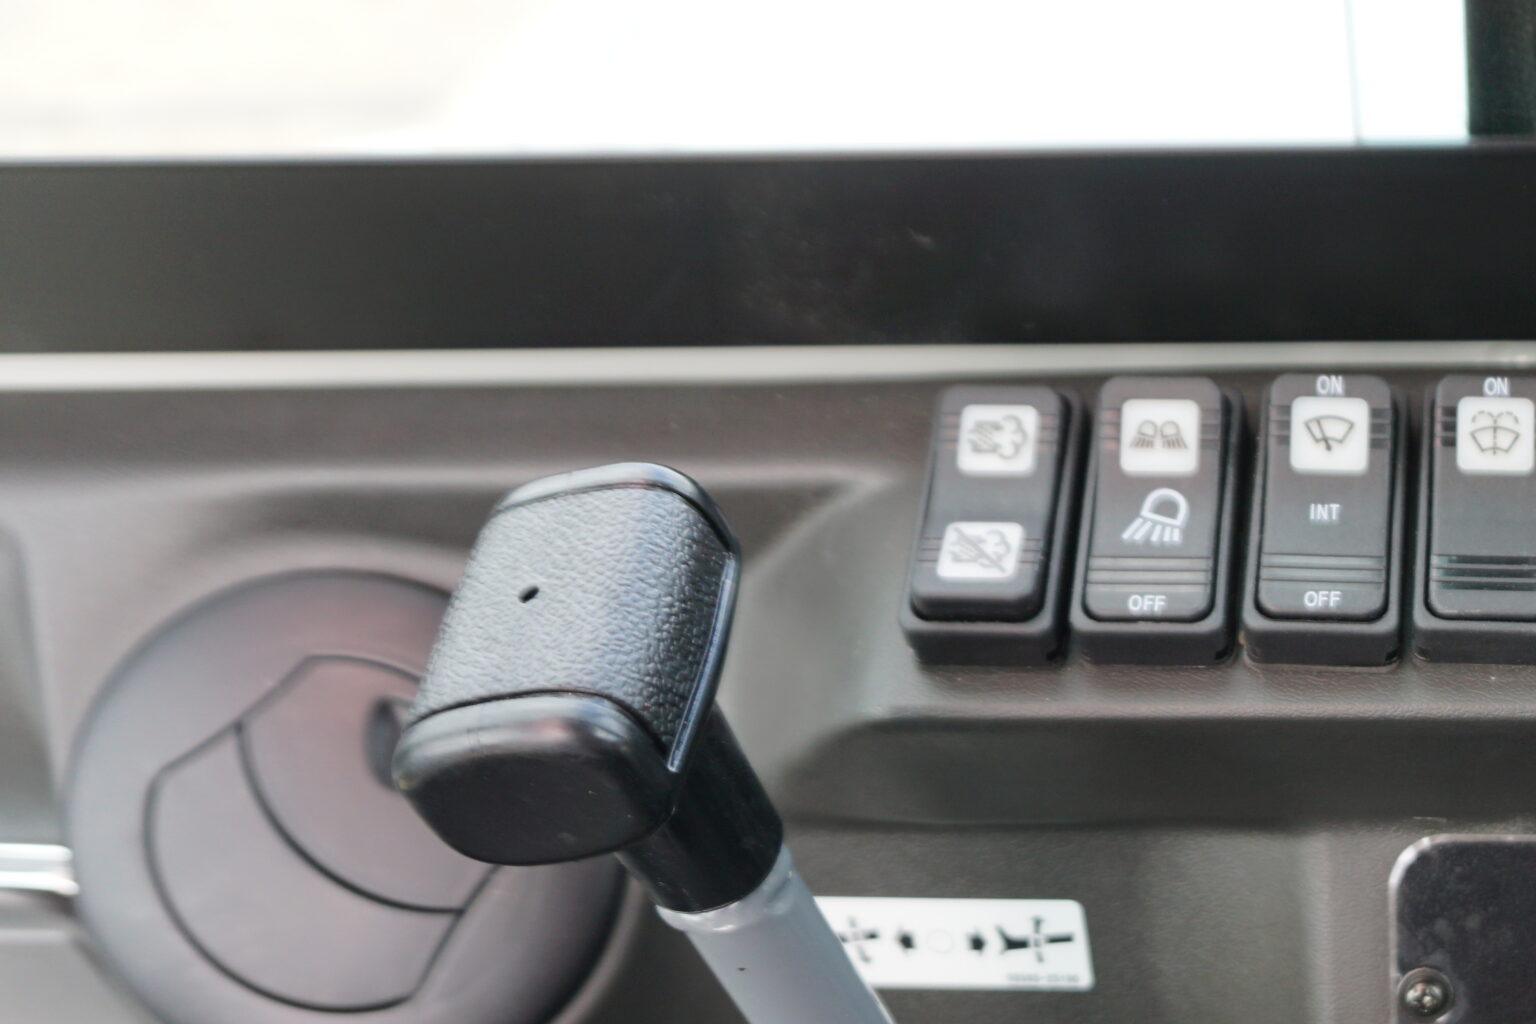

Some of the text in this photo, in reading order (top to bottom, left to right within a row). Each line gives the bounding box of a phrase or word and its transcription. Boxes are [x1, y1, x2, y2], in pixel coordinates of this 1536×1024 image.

[1315, 374, 1343, 395] ON
[1483, 376, 1509, 396] ON
[1309, 503, 1340, 521] INT
[1128, 593, 1166, 612] OFF
[1303, 590, 1341, 608] OFF
